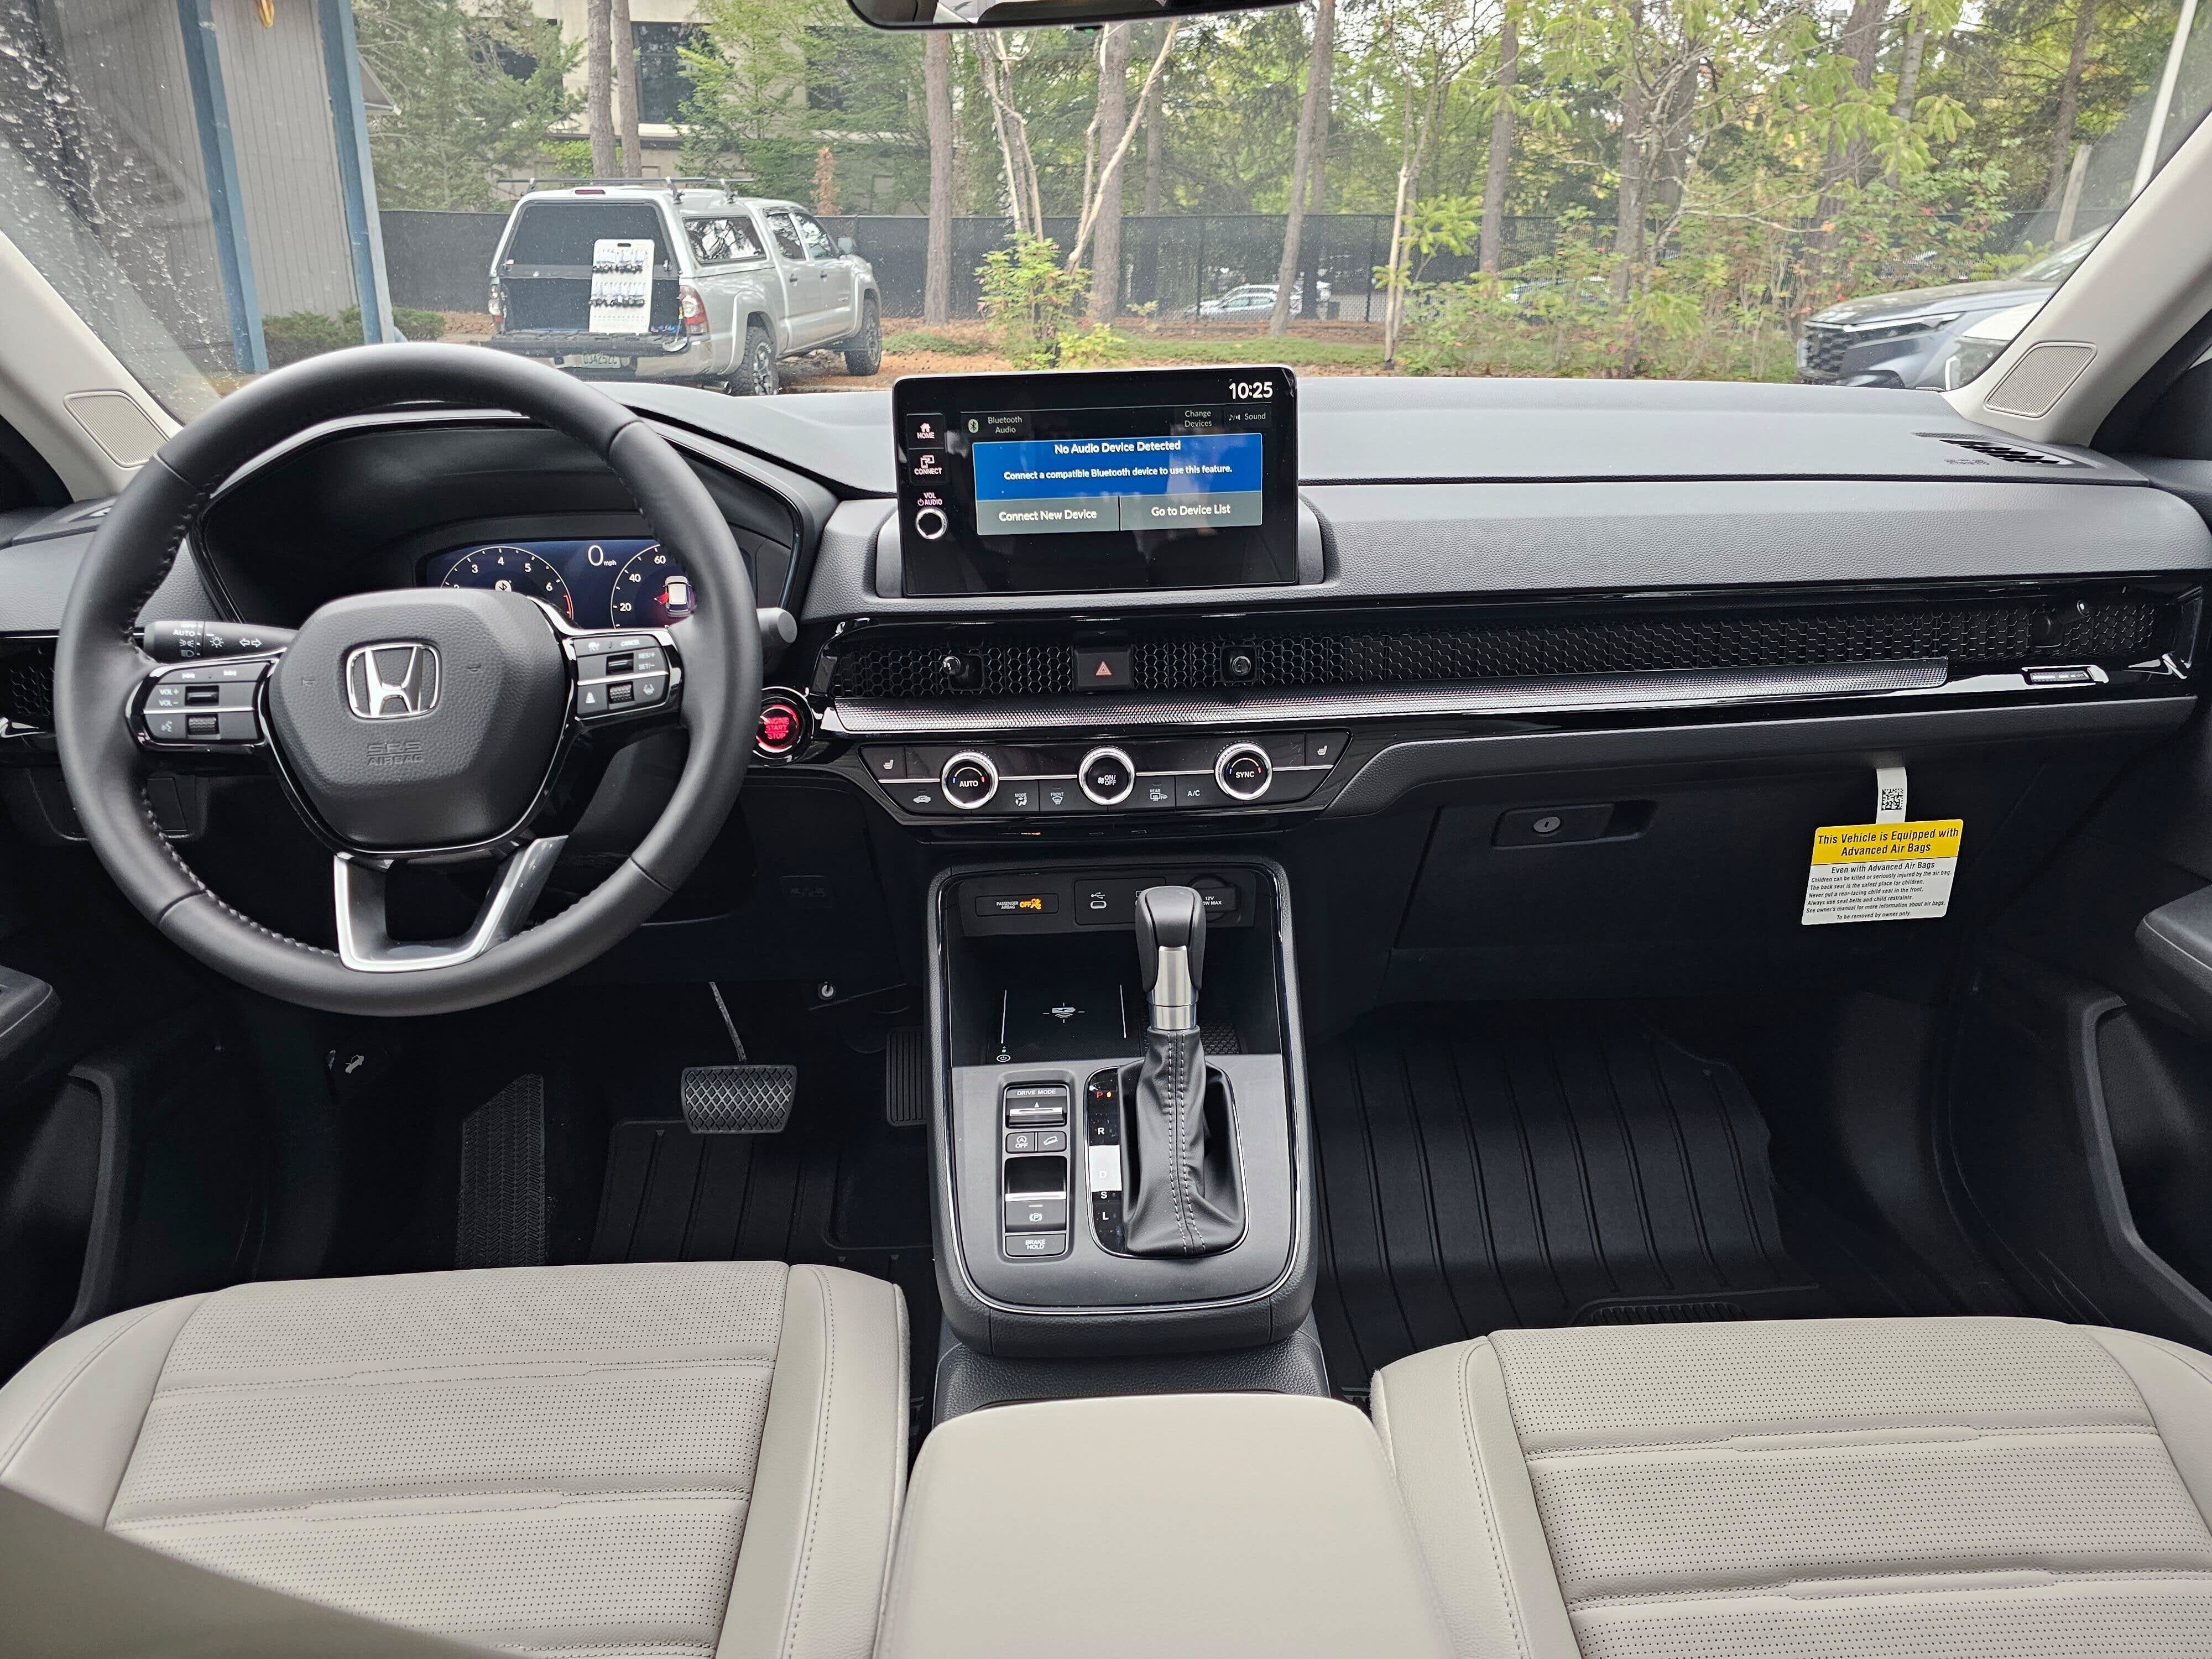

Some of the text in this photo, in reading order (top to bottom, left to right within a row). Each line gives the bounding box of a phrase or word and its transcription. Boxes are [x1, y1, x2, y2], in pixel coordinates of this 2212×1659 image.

[1229, 382, 1273, 399] 10:25
[988, 416, 1022, 424] Bluetooth
[1054, 440, 1181, 454] No Audio Device Detected
[1004, 471, 1038, 480] Connect
[1046, 469, 1089, 479] compatible
[1091, 467, 1130, 477] Bluetooth
[1132, 467, 1157, 476] device
[1186, 466, 1200, 474] this
[1202, 465, 1233, 473] feature.
[999, 509, 1097, 521] Connect New Device
[1151, 504, 1231, 517] Go to Device List
[588, 545, 604, 566] 0
[654, 555, 666, 565] 60
[497, 556, 504, 566] 4
[472, 564, 478, 573] 3
[525, 563, 531, 572] 5
[629, 573, 641, 582] 40
[546, 582, 553, 591] 6
[619, 603, 632, 612] 20
[1818, 828, 1959, 844] This Vehicle is Equipped with
[1841, 843, 1931, 856] Advanced Air Bags
[1867, 863, 1902, 872] Advanced
[1102, 1212, 1109, 1220] L
